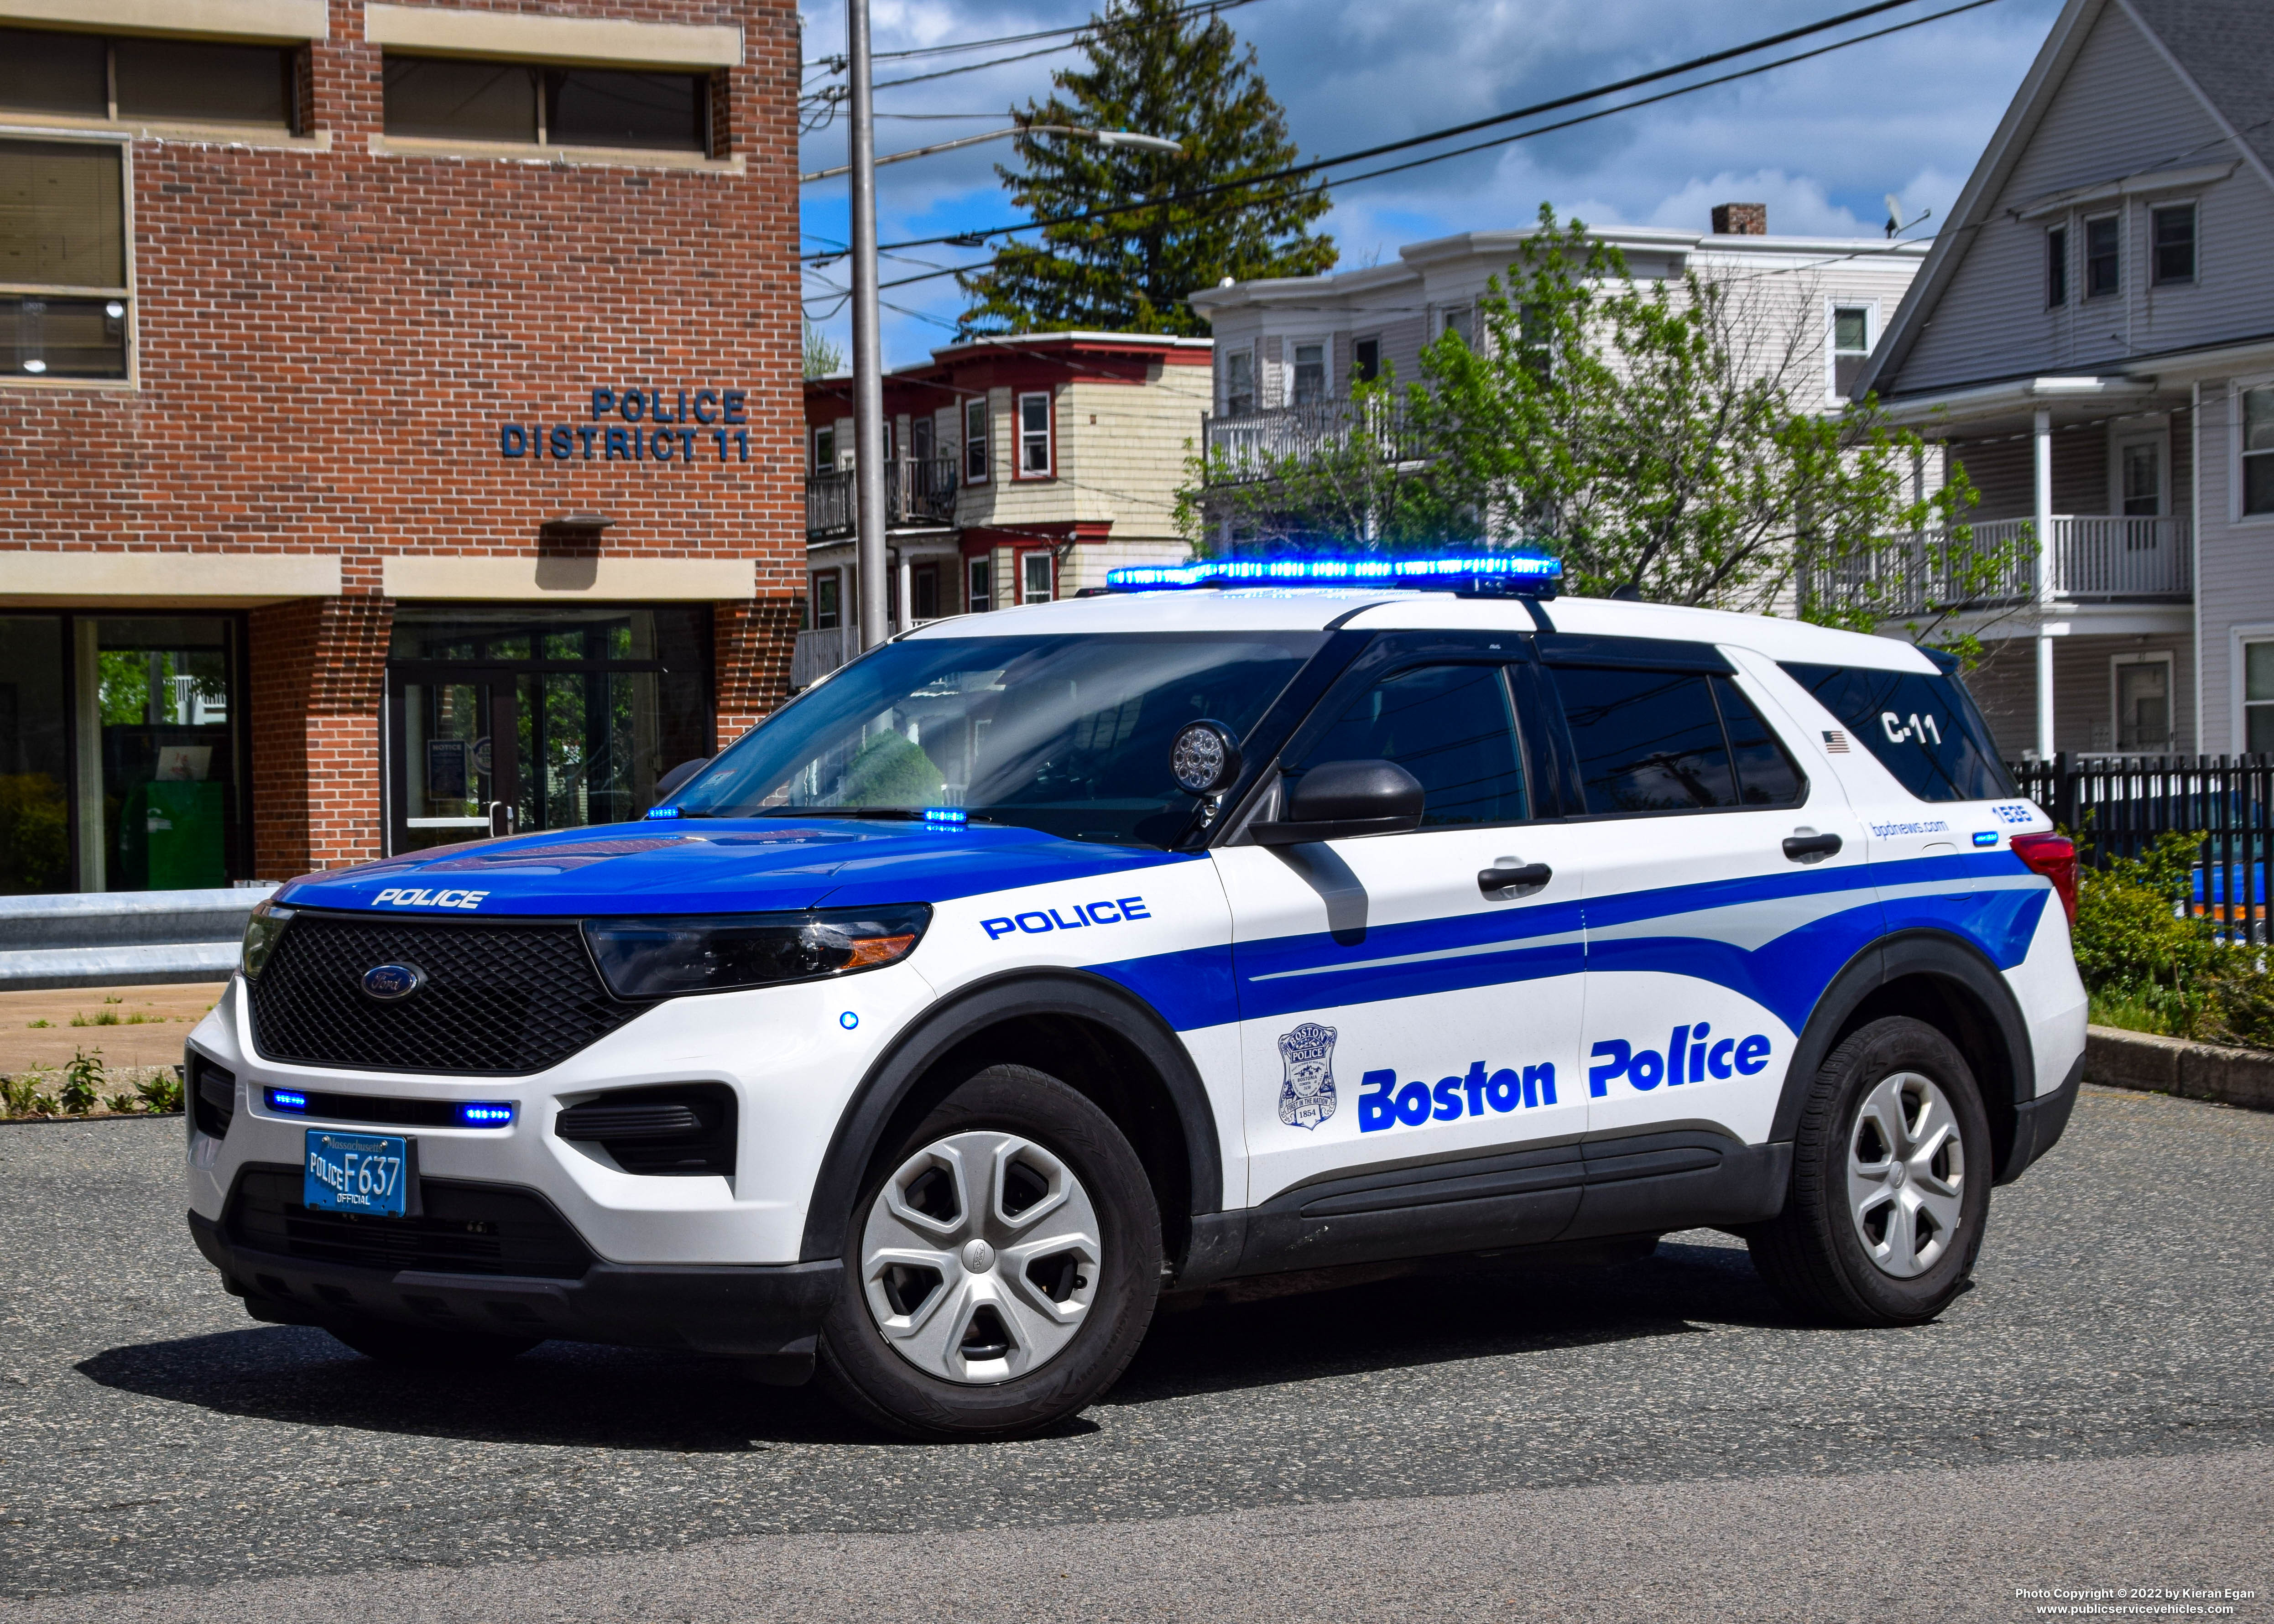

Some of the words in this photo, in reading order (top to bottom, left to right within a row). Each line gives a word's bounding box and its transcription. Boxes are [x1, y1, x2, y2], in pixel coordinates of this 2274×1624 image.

[593, 388, 746, 423] POLICE
[502, 424, 697, 462] DISTRICT
[714, 429, 748, 461] 11
[1882, 712, 1941, 744] C-11
[1992, 805, 2033, 823] 1535
[1870, 820, 1949, 841] bpdnews.com
[371, 889, 490, 909] POLICE
[979, 896, 1152, 941] POLICE
[371, 972, 402, 990] Ford
[1290, 1027, 1325, 1044] BOSTON
[1292, 1047, 1324, 1062] POLICE
[1358, 1061, 1558, 1134] Boston
[1589, 1022, 1771, 1098] Police
[1287, 1101, 1298, 1112] FIRST
[1313, 1097, 1328, 1105] NATION
[1299, 1109, 1316, 1119] 1854
[328, 1138, 382, 1153] Massachusetts
[310, 1152, 343, 1191] POLICE
[344, 1153, 400, 1196] F637
[337, 1193, 370, 1205] OFFICIAL
